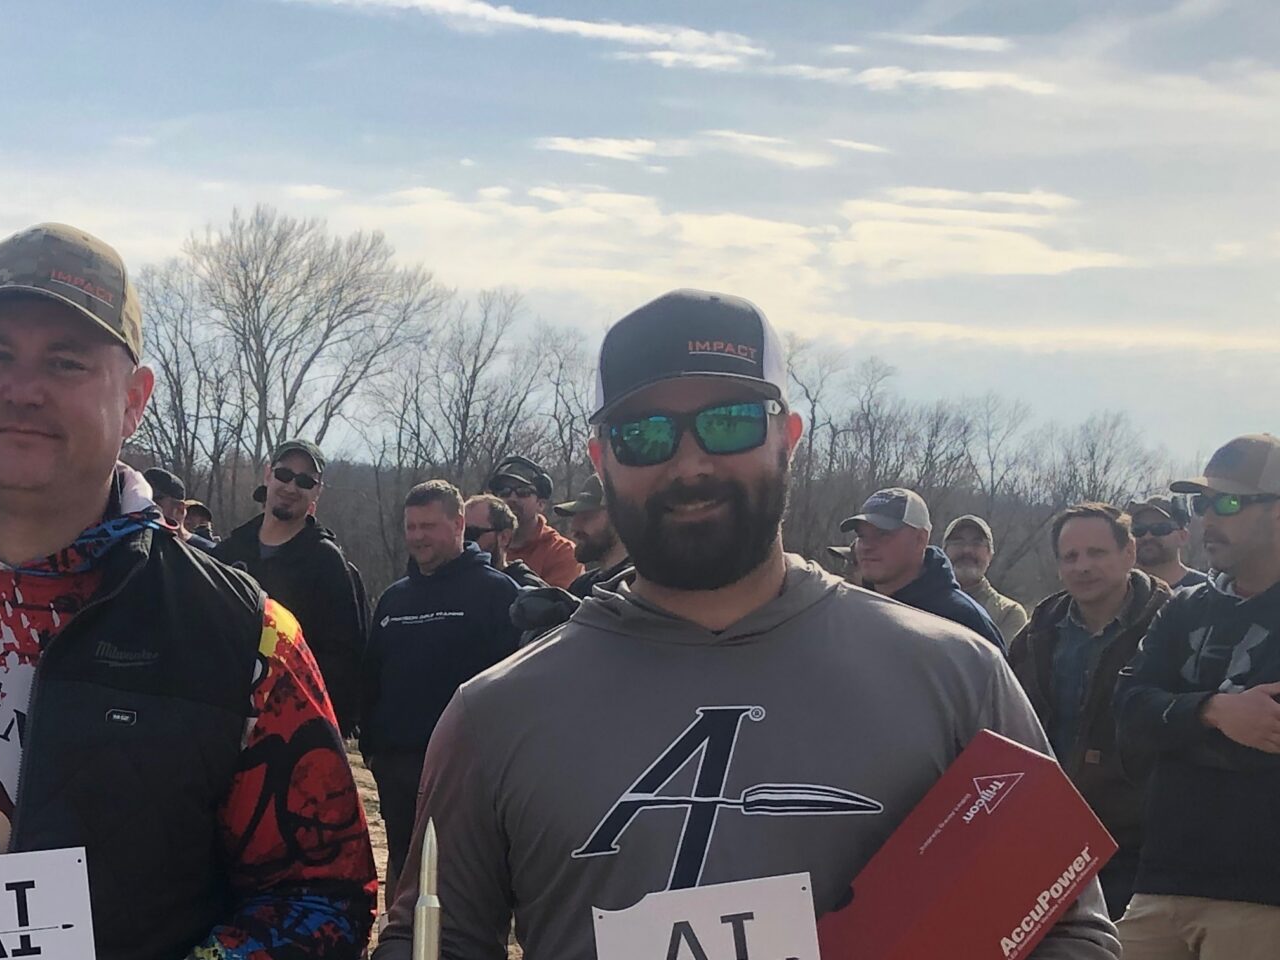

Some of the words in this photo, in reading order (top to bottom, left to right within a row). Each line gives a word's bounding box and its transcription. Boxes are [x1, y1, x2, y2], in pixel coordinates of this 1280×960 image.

[50, 269, 114, 302] IMPACT
[687, 340, 757, 360] IMPACT
[962, 779, 1006, 823] Trijicon
[1000, 846, 1092, 957] AccuPower
